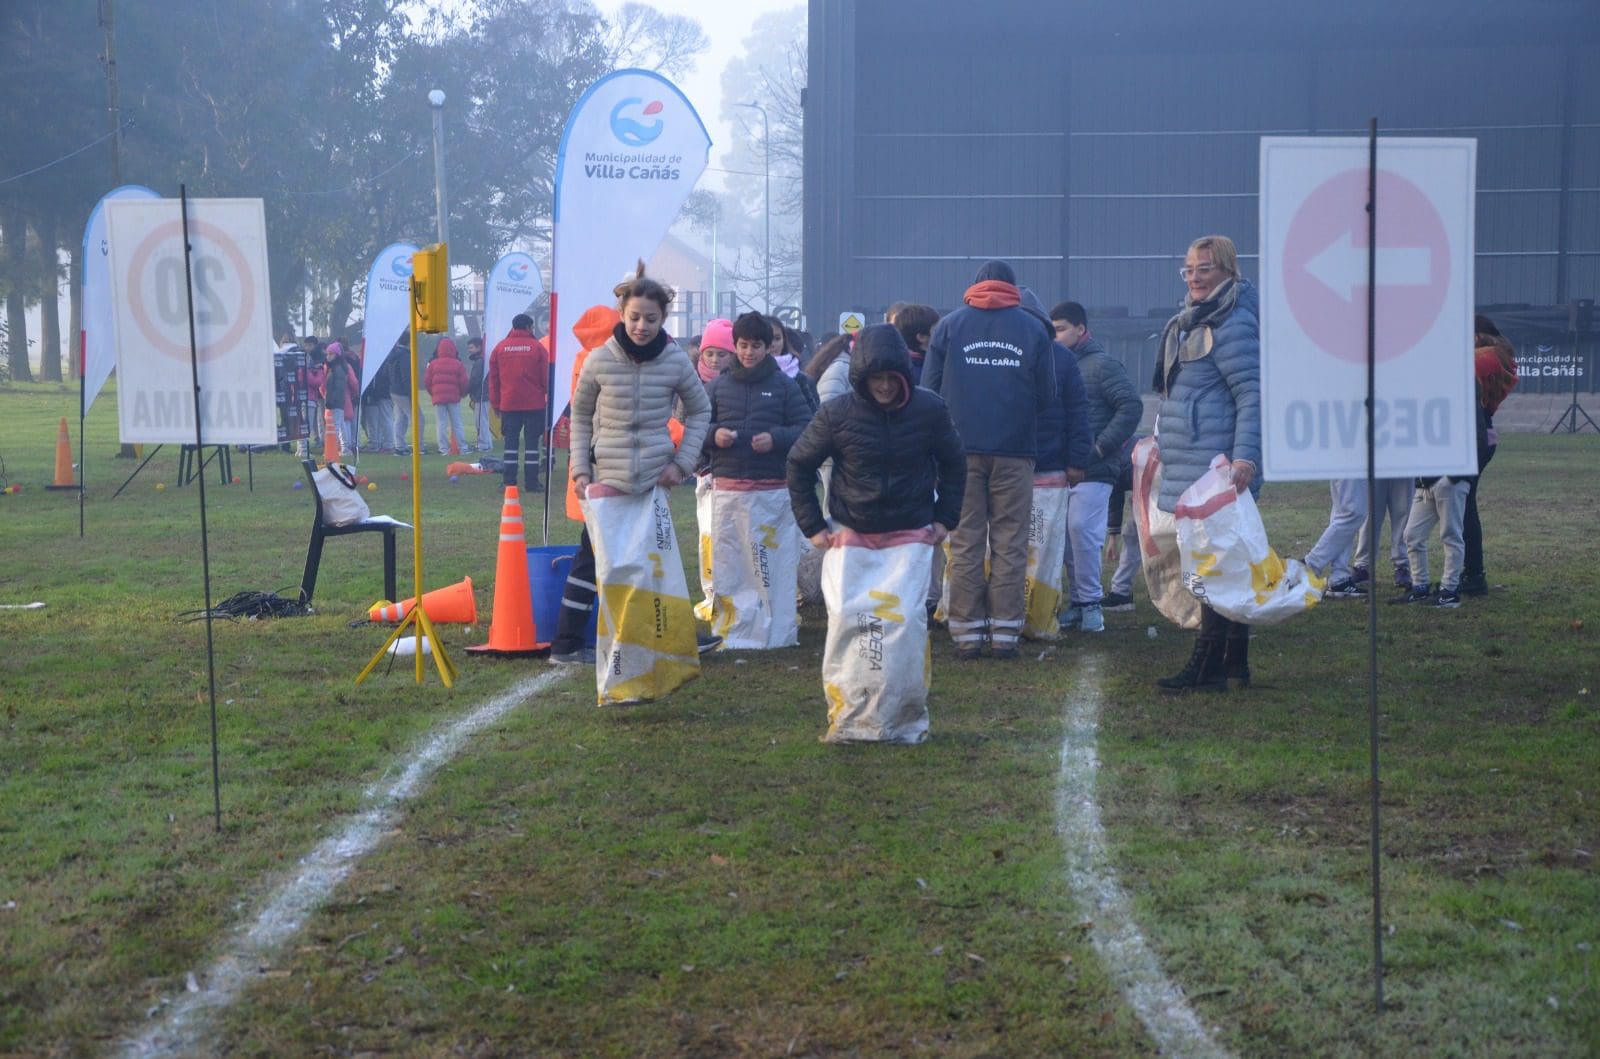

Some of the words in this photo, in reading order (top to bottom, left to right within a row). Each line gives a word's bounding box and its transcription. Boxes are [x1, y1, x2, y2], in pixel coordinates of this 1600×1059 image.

[585, 152, 666, 165] Municipalidad
[668, 155, 682, 164] de
[584, 164, 625, 179] Villa
[628, 165, 680, 180] Cañás
[963, 341, 1023, 356] MUNICIPALIDAD
[965, 357, 990, 365] VILLA
[991, 357, 1021, 367] CAÑAS
[1513, 354, 1570, 364] unicipalidad
[1515, 365, 1540, 377] illa
[1542, 365, 1584, 377] Cañás
[760, 543, 771, 587] NIDERA
[1192, 572, 1211, 606] NIDE
[868, 614, 883, 671] NIDERA
[613, 650, 622, 676] TRIGO
